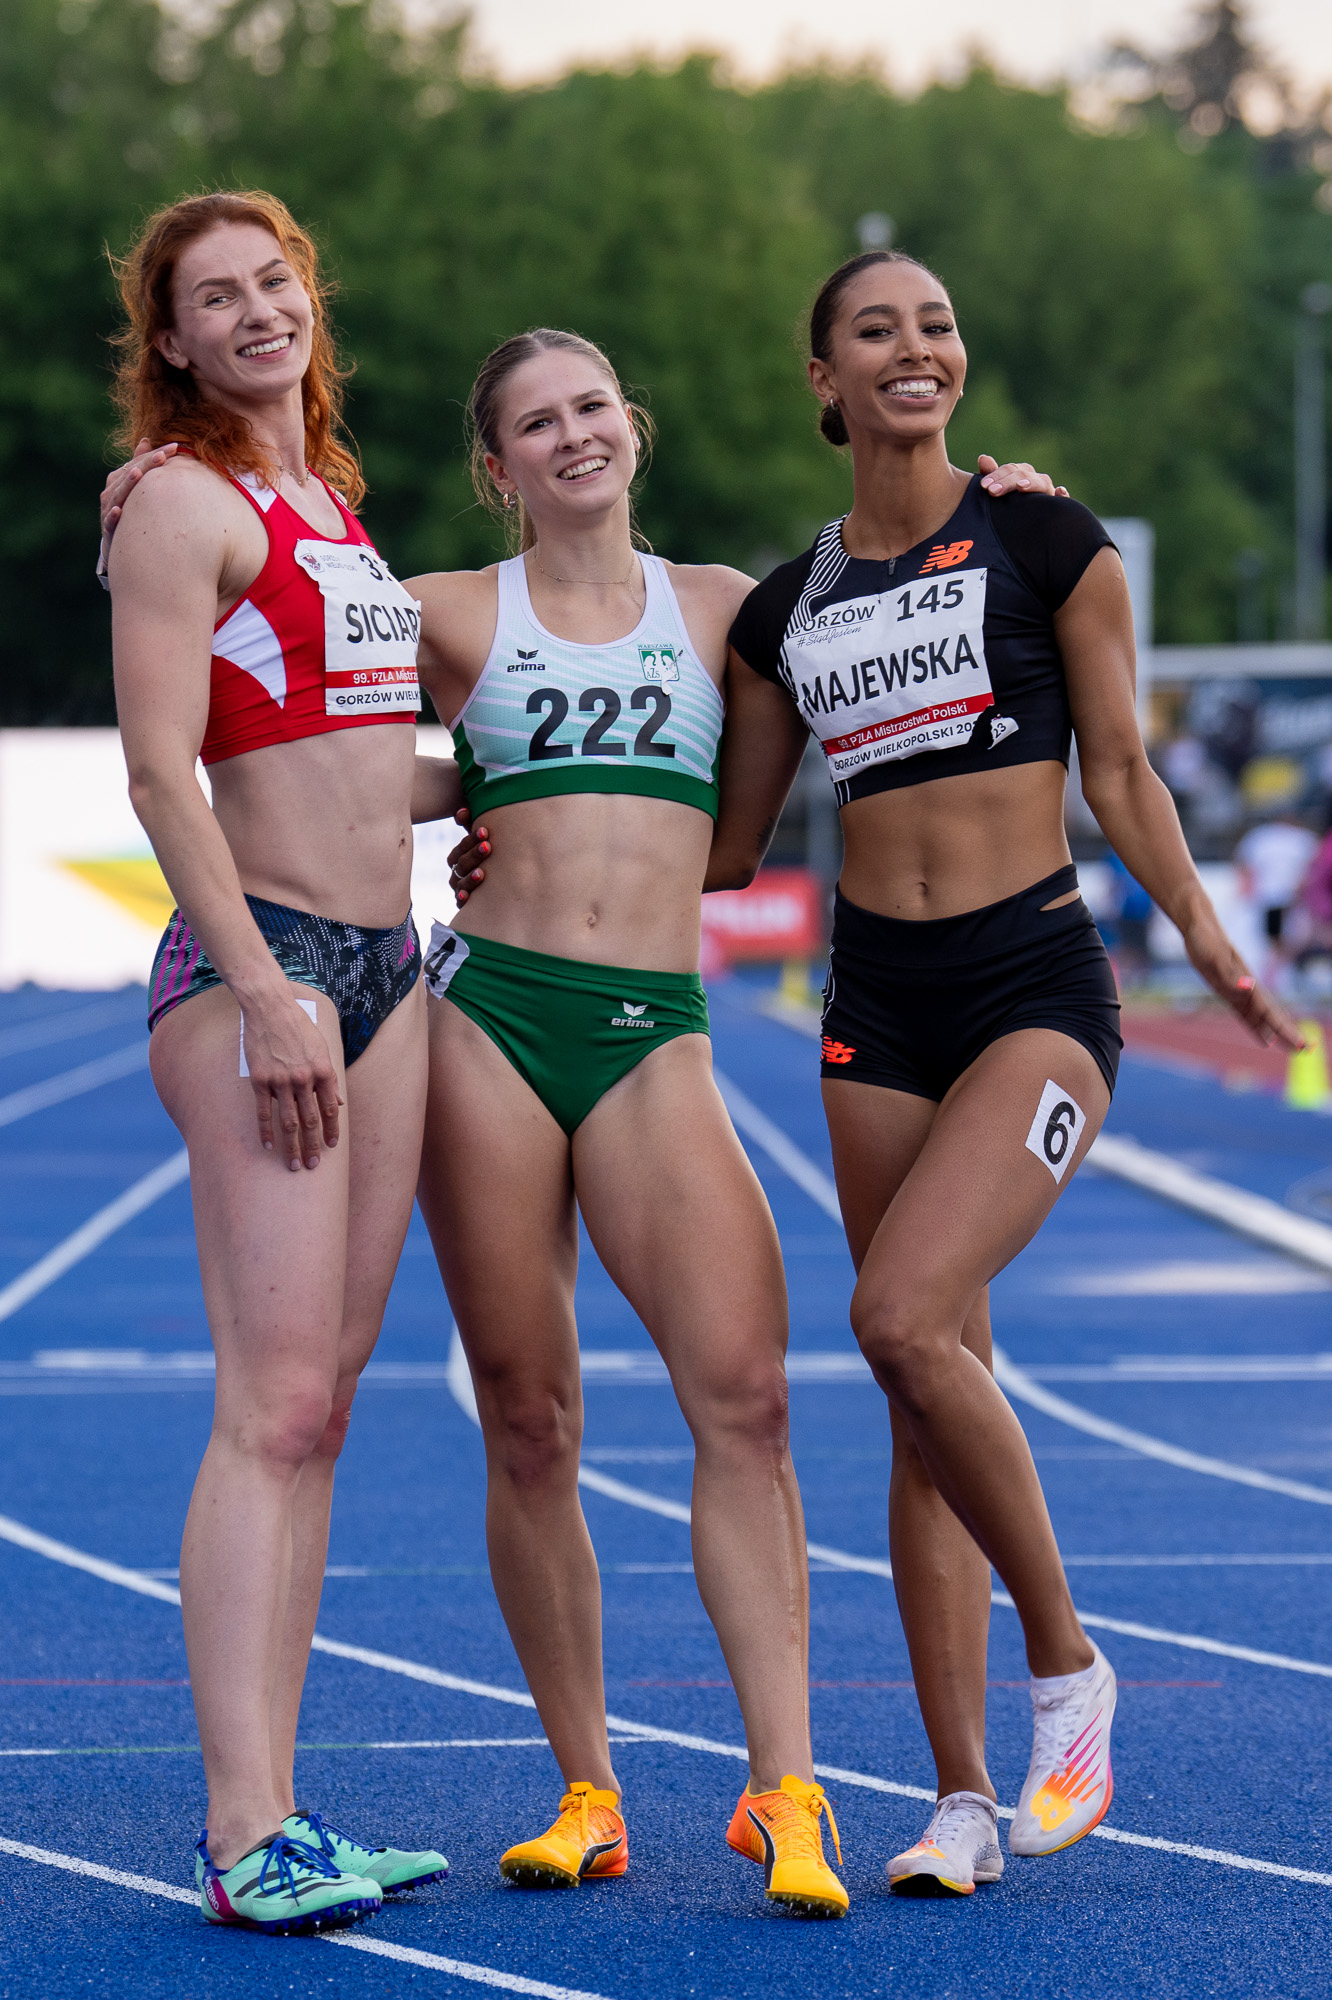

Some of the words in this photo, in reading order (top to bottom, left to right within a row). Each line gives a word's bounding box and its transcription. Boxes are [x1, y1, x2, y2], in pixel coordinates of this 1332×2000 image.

[794, 605, 875, 635] ORZÓW
[896, 579, 964, 622] 145
[345, 603, 422, 644] SICIAR
[353, 672, 370, 685] 99.
[372, 671, 394, 683] PZLA
[395, 670, 419, 681] Mistrz
[507, 662, 546, 673] erima
[801, 633, 979, 719] MAJEWSKA
[336, 690, 392, 706] GORZÓW
[394, 690, 421, 701] WIELK
[526, 685, 676, 761] 222
[849, 730, 874, 747] PZLA
[874, 712, 931, 739] Mistrzostwa
[932, 701, 968, 720] Polski
[834, 751, 871, 771] GORZÓW
[873, 726, 954, 758] WIELKOPOLSKI
[611, 1017, 655, 1028] erima
[1043, 1101, 1076, 1165] 6
